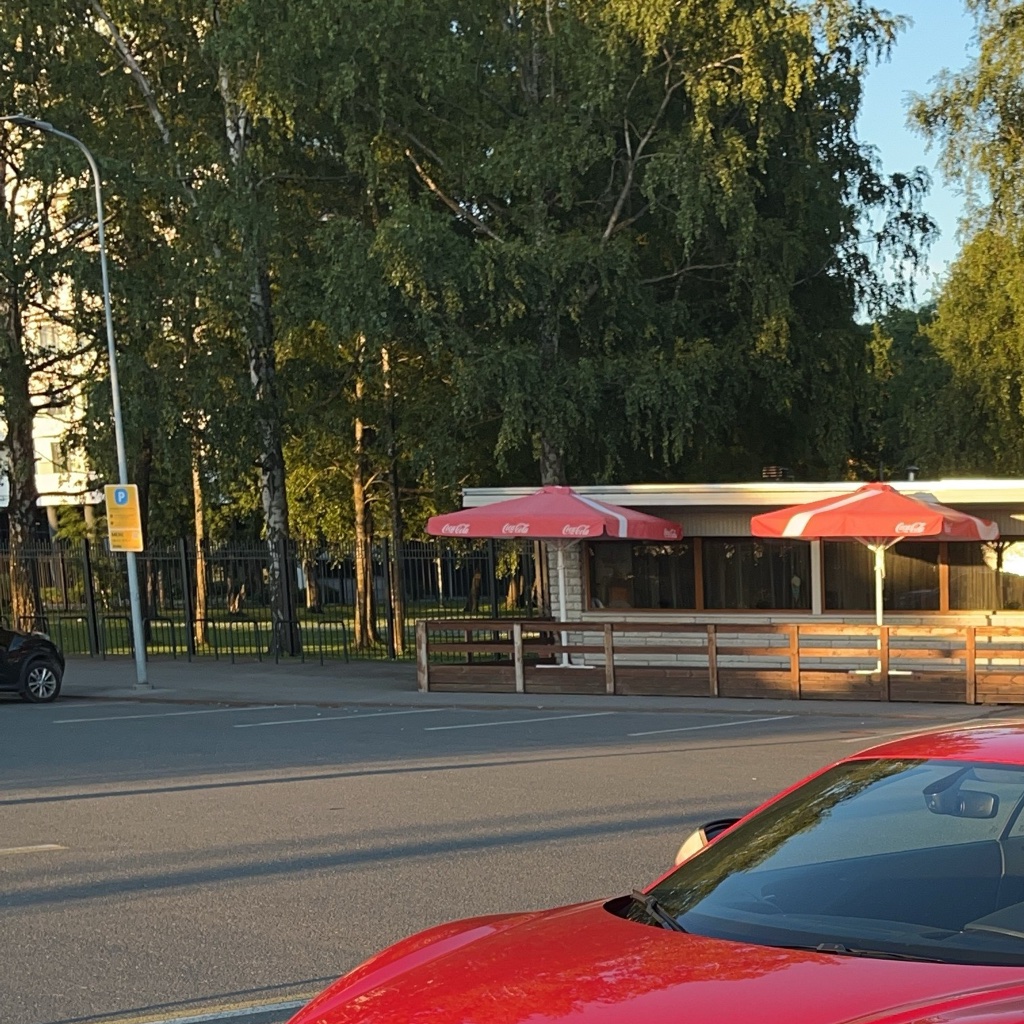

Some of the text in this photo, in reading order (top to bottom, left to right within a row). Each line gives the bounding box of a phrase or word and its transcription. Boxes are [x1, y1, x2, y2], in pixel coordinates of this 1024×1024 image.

[117, 491, 126, 503] P
[442, 523, 470, 534] Coca-Cola
[502, 523, 530, 534] Coca-Cola
[562, 524, 591, 535] Coca-Cola
[895, 522, 926, 533] Coca-Cola
